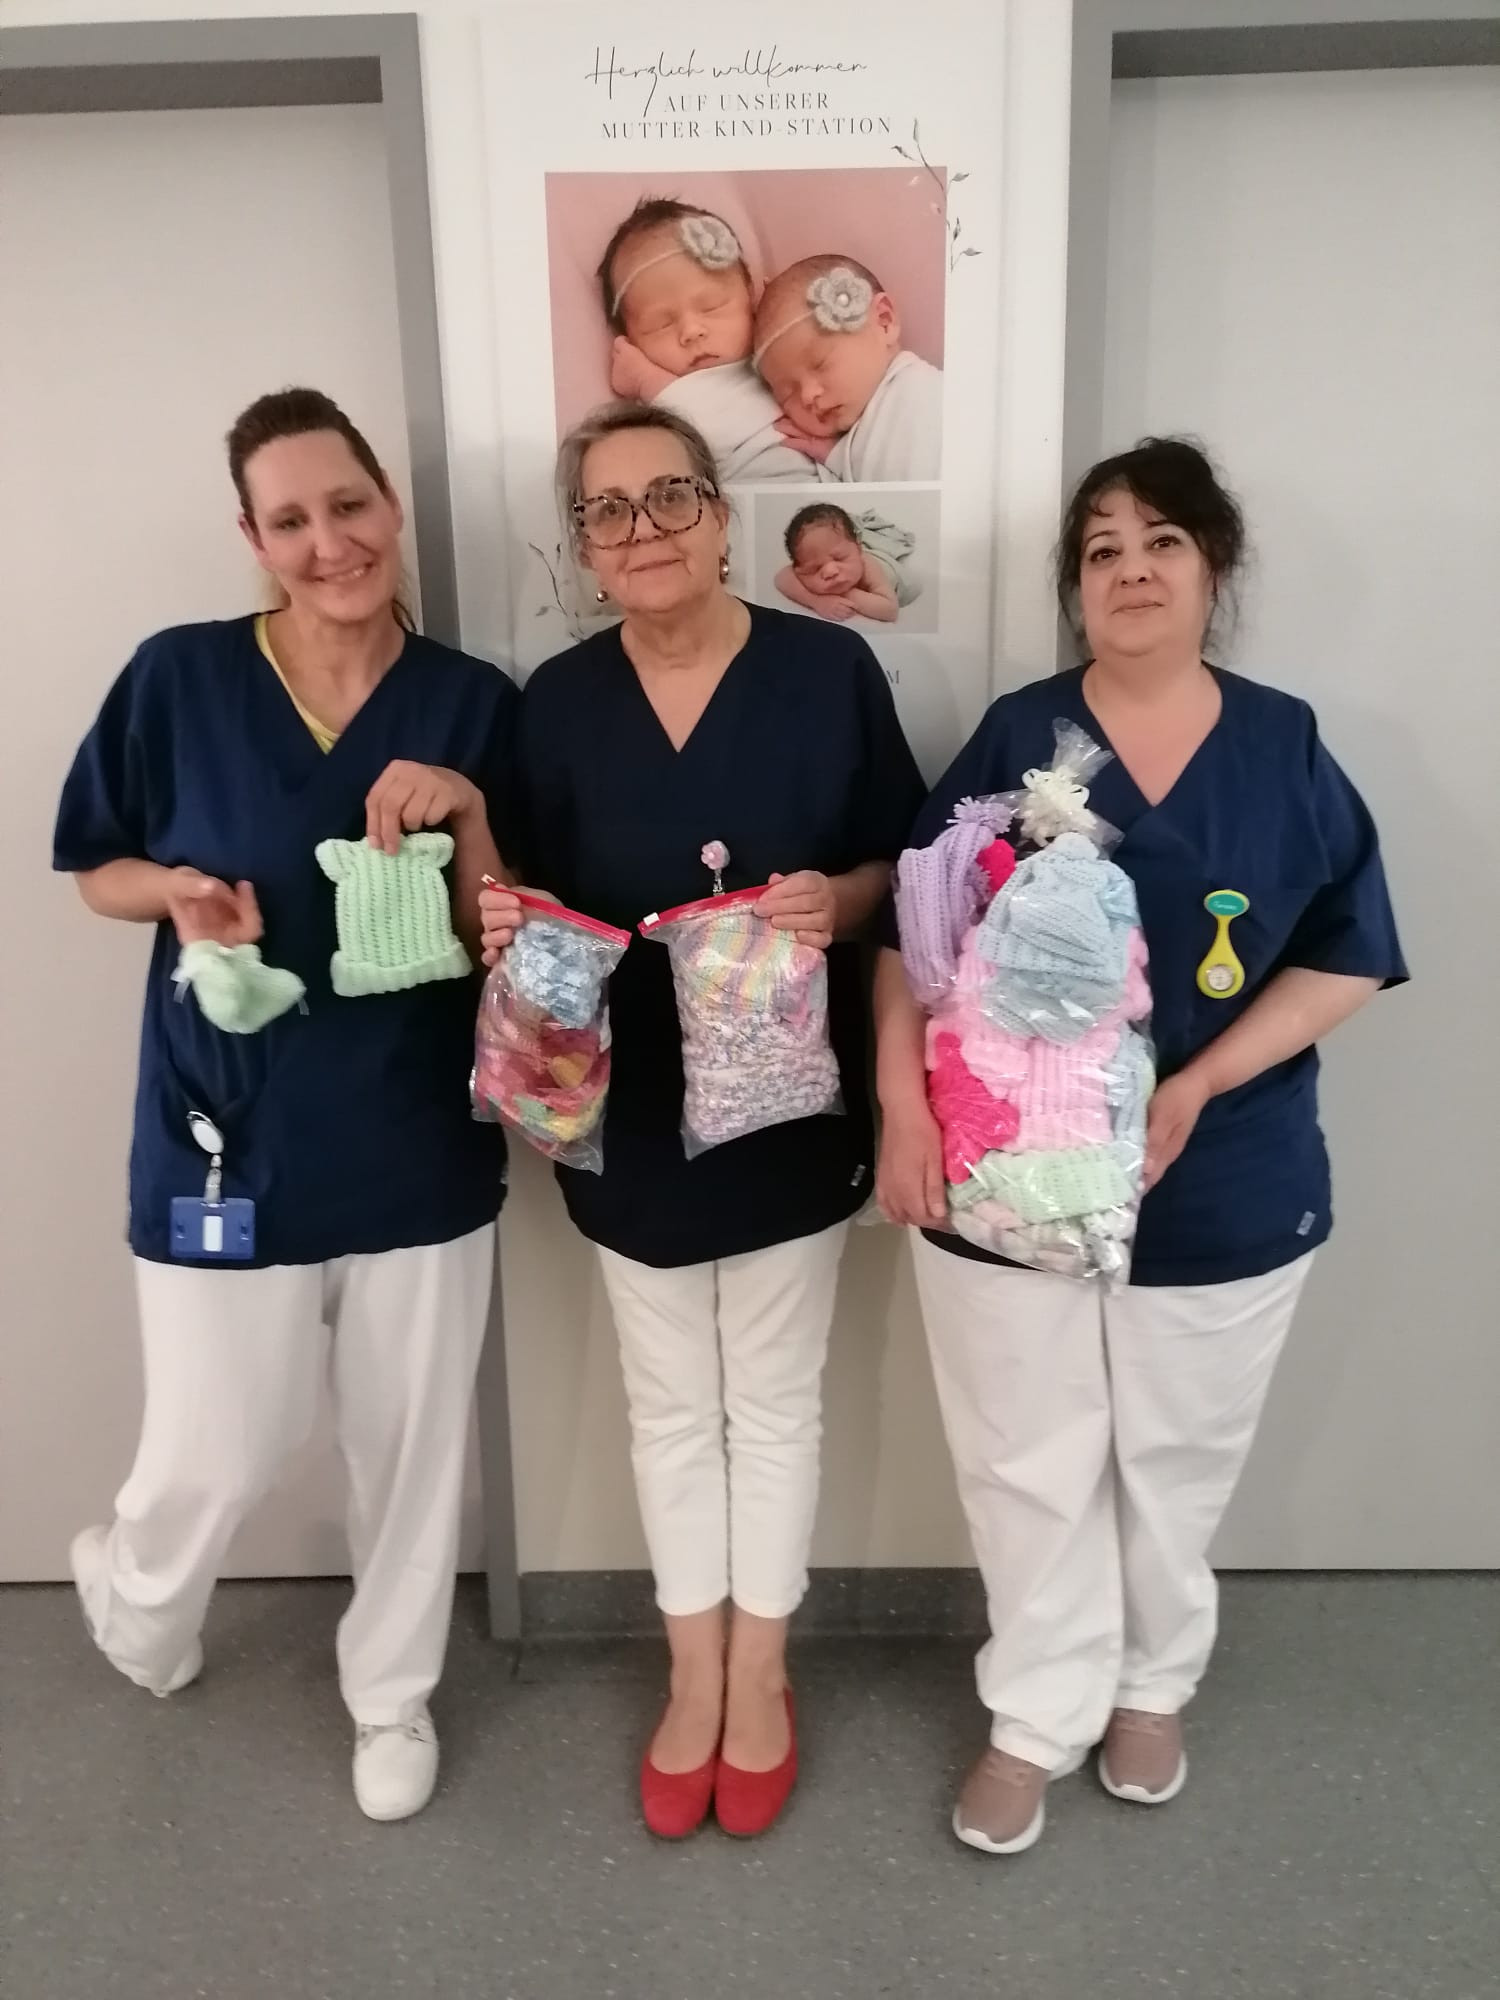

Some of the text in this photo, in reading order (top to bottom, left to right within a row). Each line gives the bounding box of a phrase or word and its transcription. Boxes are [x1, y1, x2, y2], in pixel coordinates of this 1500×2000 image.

[585, 45, 868, 118] Herzlich willkommen
[664, 92, 829, 112] AUF UNSERER
